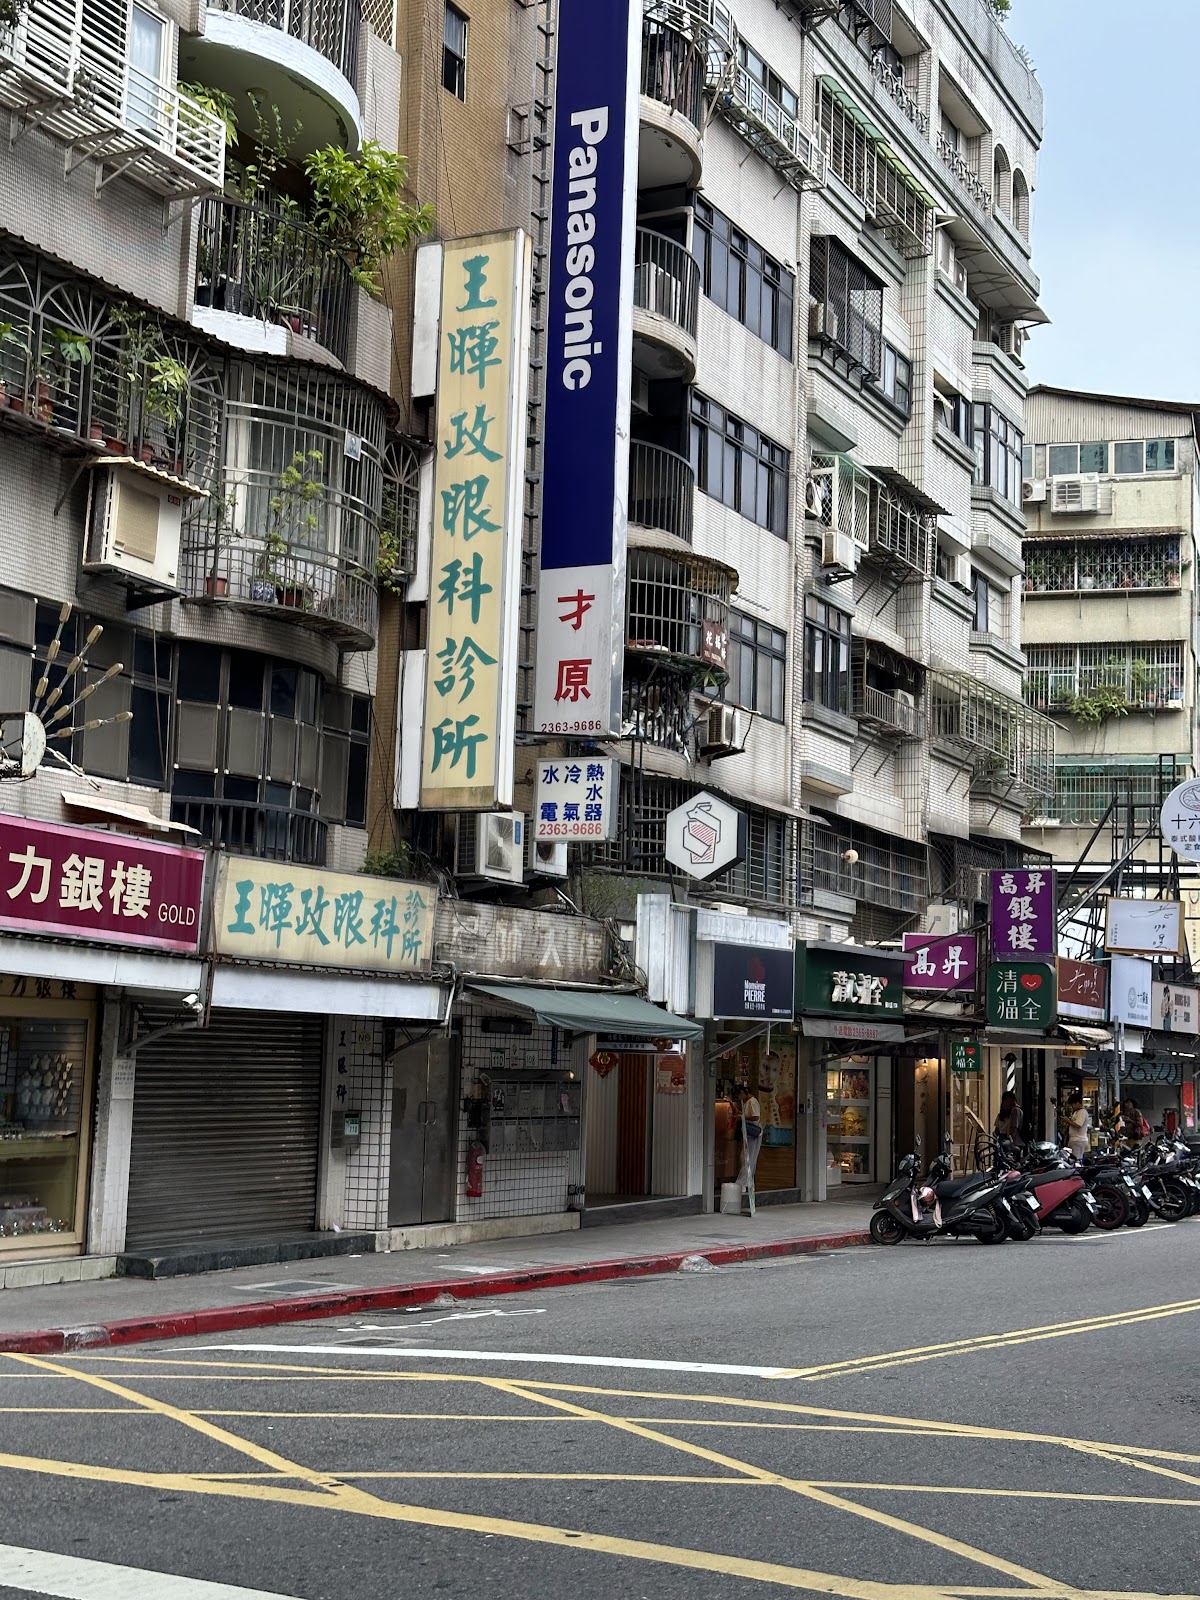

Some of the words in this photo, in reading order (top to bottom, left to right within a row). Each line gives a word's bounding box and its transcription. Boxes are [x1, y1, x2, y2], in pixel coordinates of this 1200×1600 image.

[563, 106, 608, 391] Panasonic
[554, 588, 595, 702] 才原
[541, 720, 602, 733] 2363-9686
[539, 822, 602, 835] 2363-9686
[6, 845, 153, 919] 力銀樓
[158, 902, 196, 926] GOLD
[998, 872, 1046, 895] 高昇
[1002, 895, 1038, 951] 銀樓
[910, 945, 969, 980] 高昇
[744, 989, 766, 1003] PIERRE
